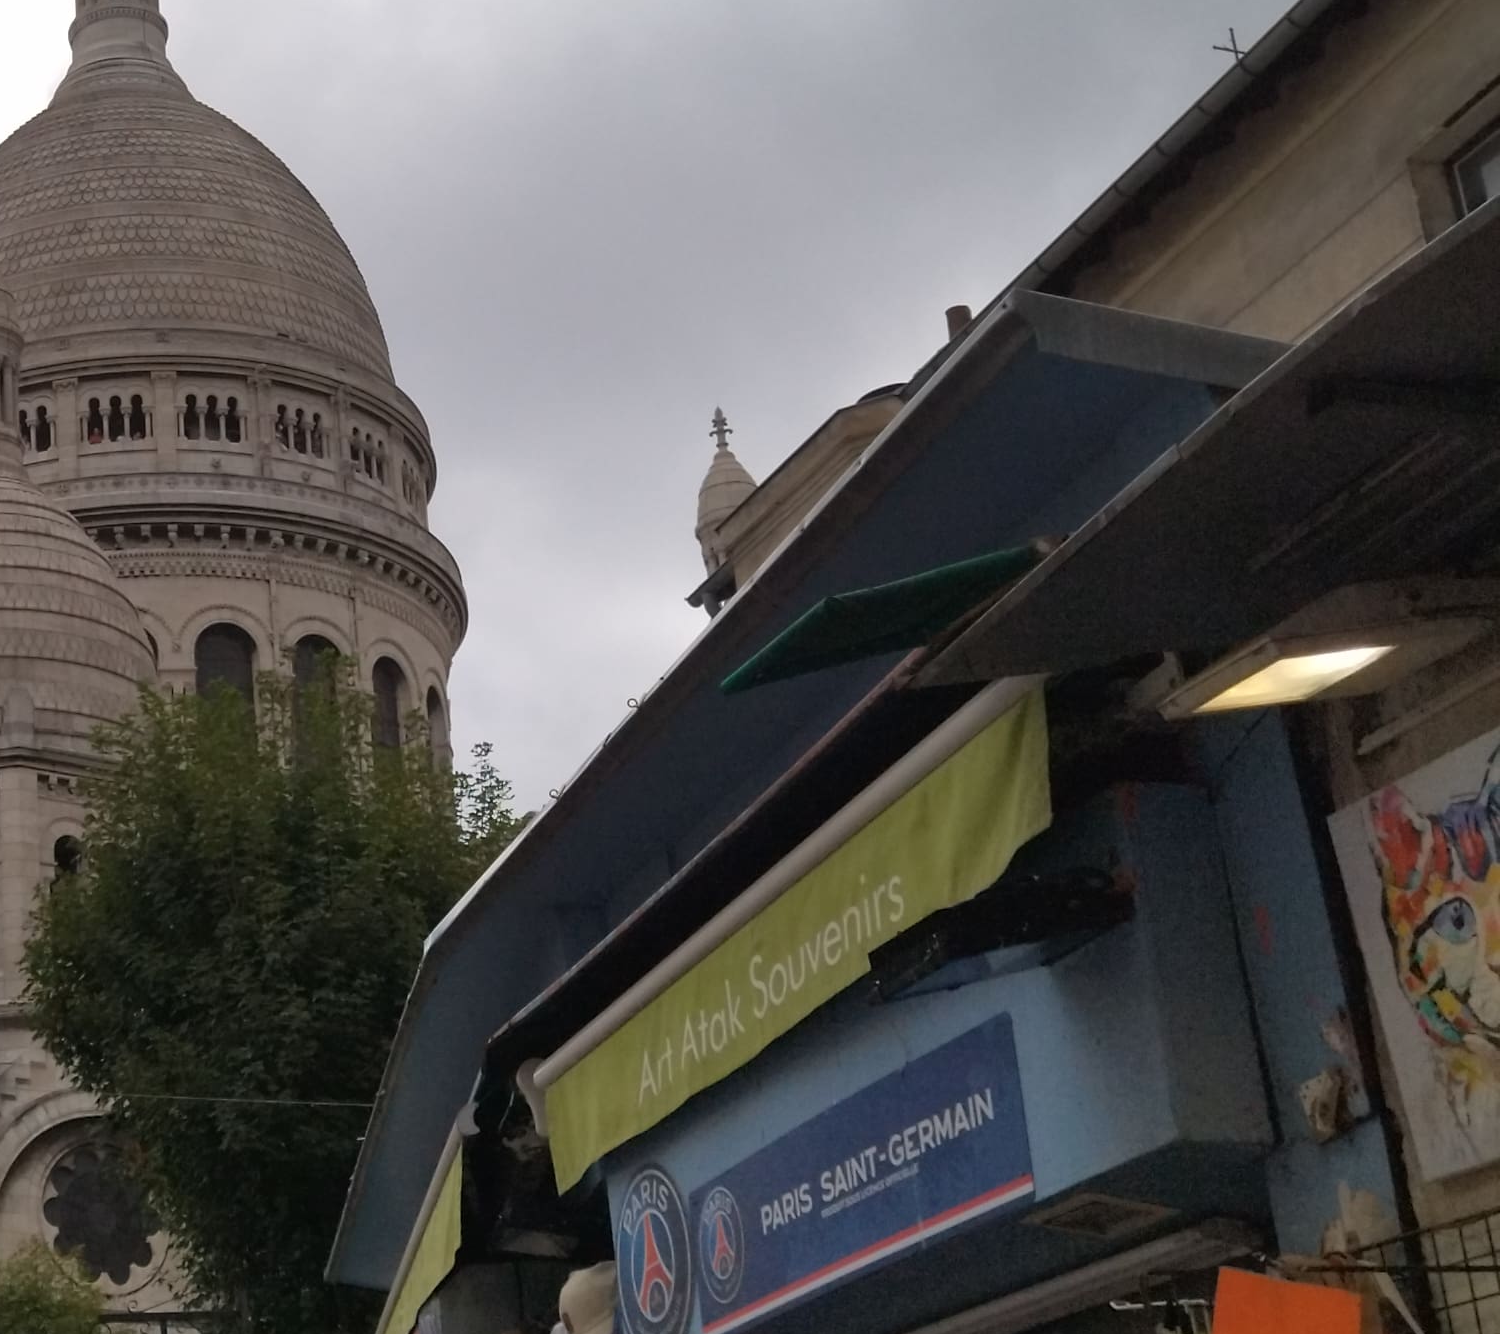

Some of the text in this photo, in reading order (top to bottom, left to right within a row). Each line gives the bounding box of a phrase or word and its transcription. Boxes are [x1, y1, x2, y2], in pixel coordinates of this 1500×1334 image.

[638, 874, 905, 1107] Art Atak Souvenirs
[622, 1181, 669, 1236] PARIS
[760, 1088, 995, 1236] PARIS SAINT-GERMAIN
